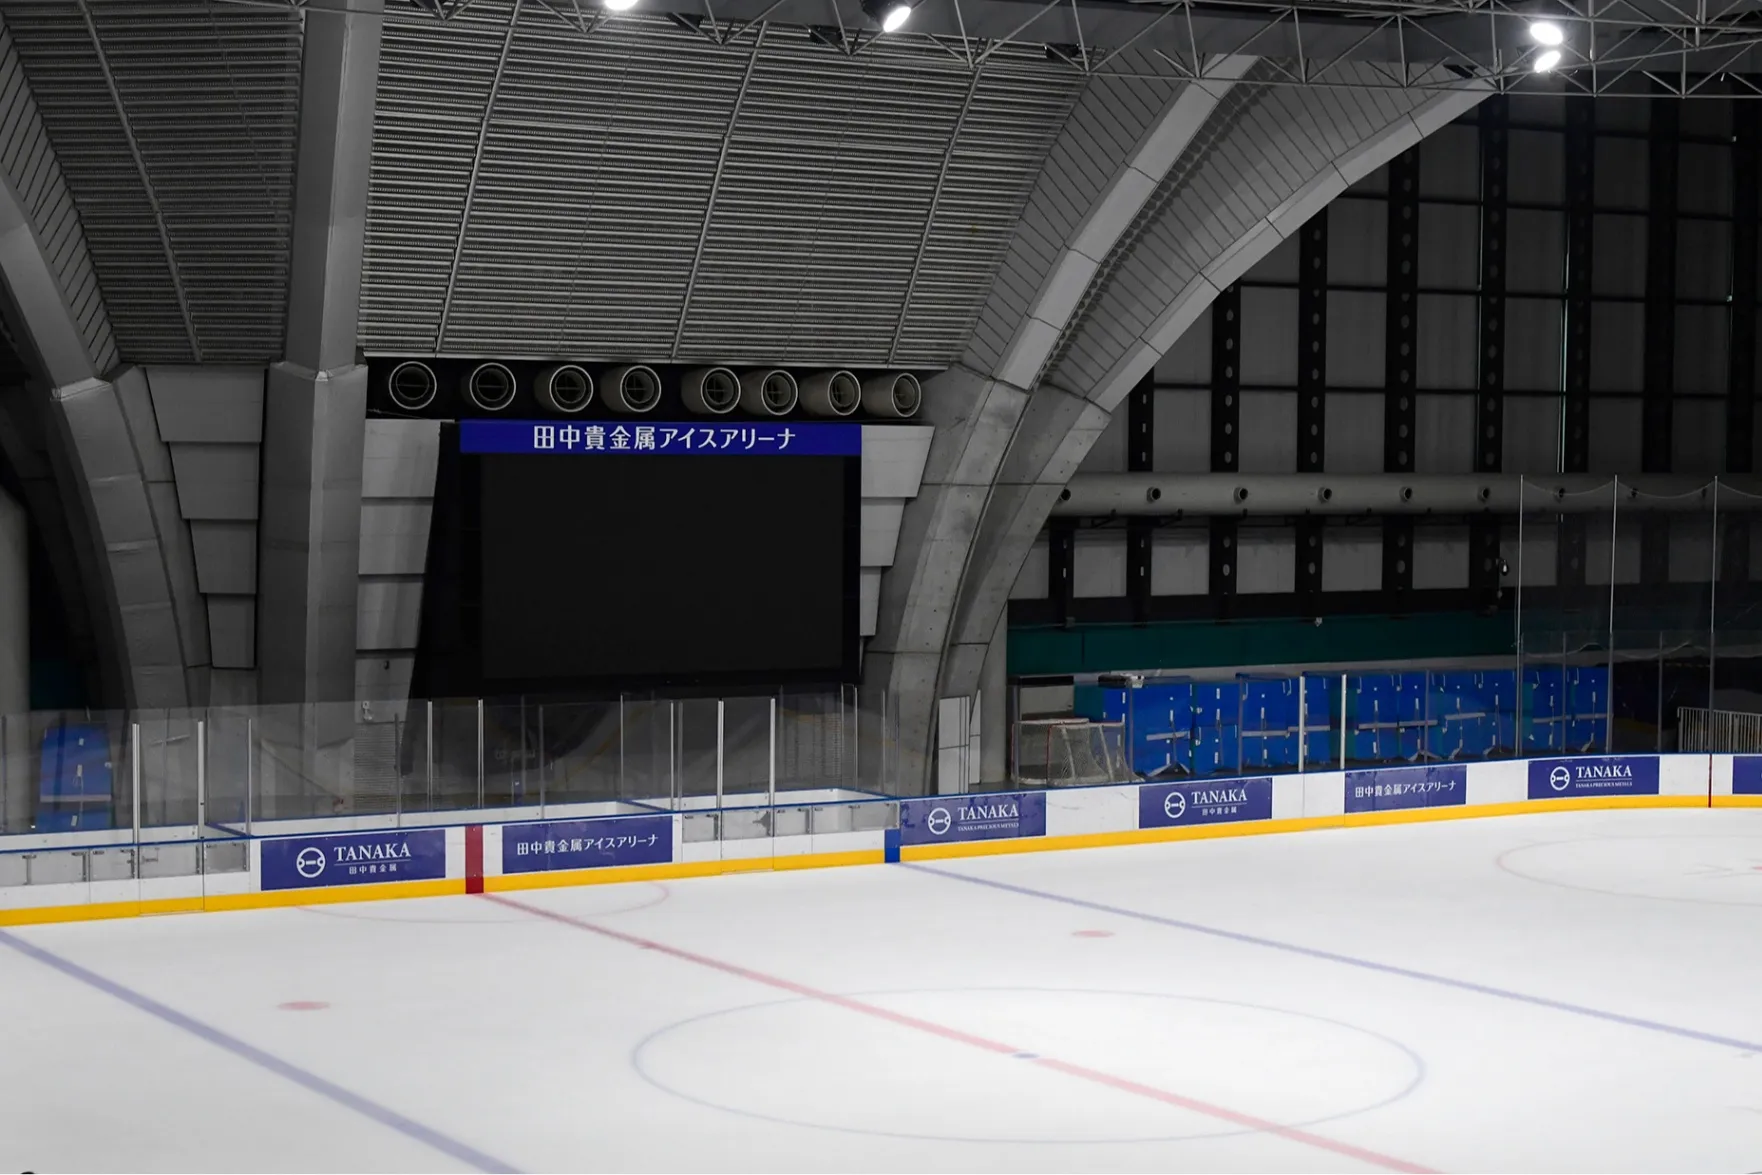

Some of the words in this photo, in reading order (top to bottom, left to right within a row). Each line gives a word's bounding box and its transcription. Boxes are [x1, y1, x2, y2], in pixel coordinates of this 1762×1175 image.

[533, 425, 796, 451] 田中貴金属アイスアリーナ
[1575, 764, 1632, 778] TANAKA
[1191, 788, 1247, 804] TANAKA
[1355, 780, 1456, 798] 田中貴金属アイスアリーナ
[957, 804, 1019, 820] TANAKA
[334, 842, 411, 861] TANAKA
[517, 834, 659, 855] 田中貴金属アイスアリーナ
[349, 863, 397, 874] 田中貴金属
